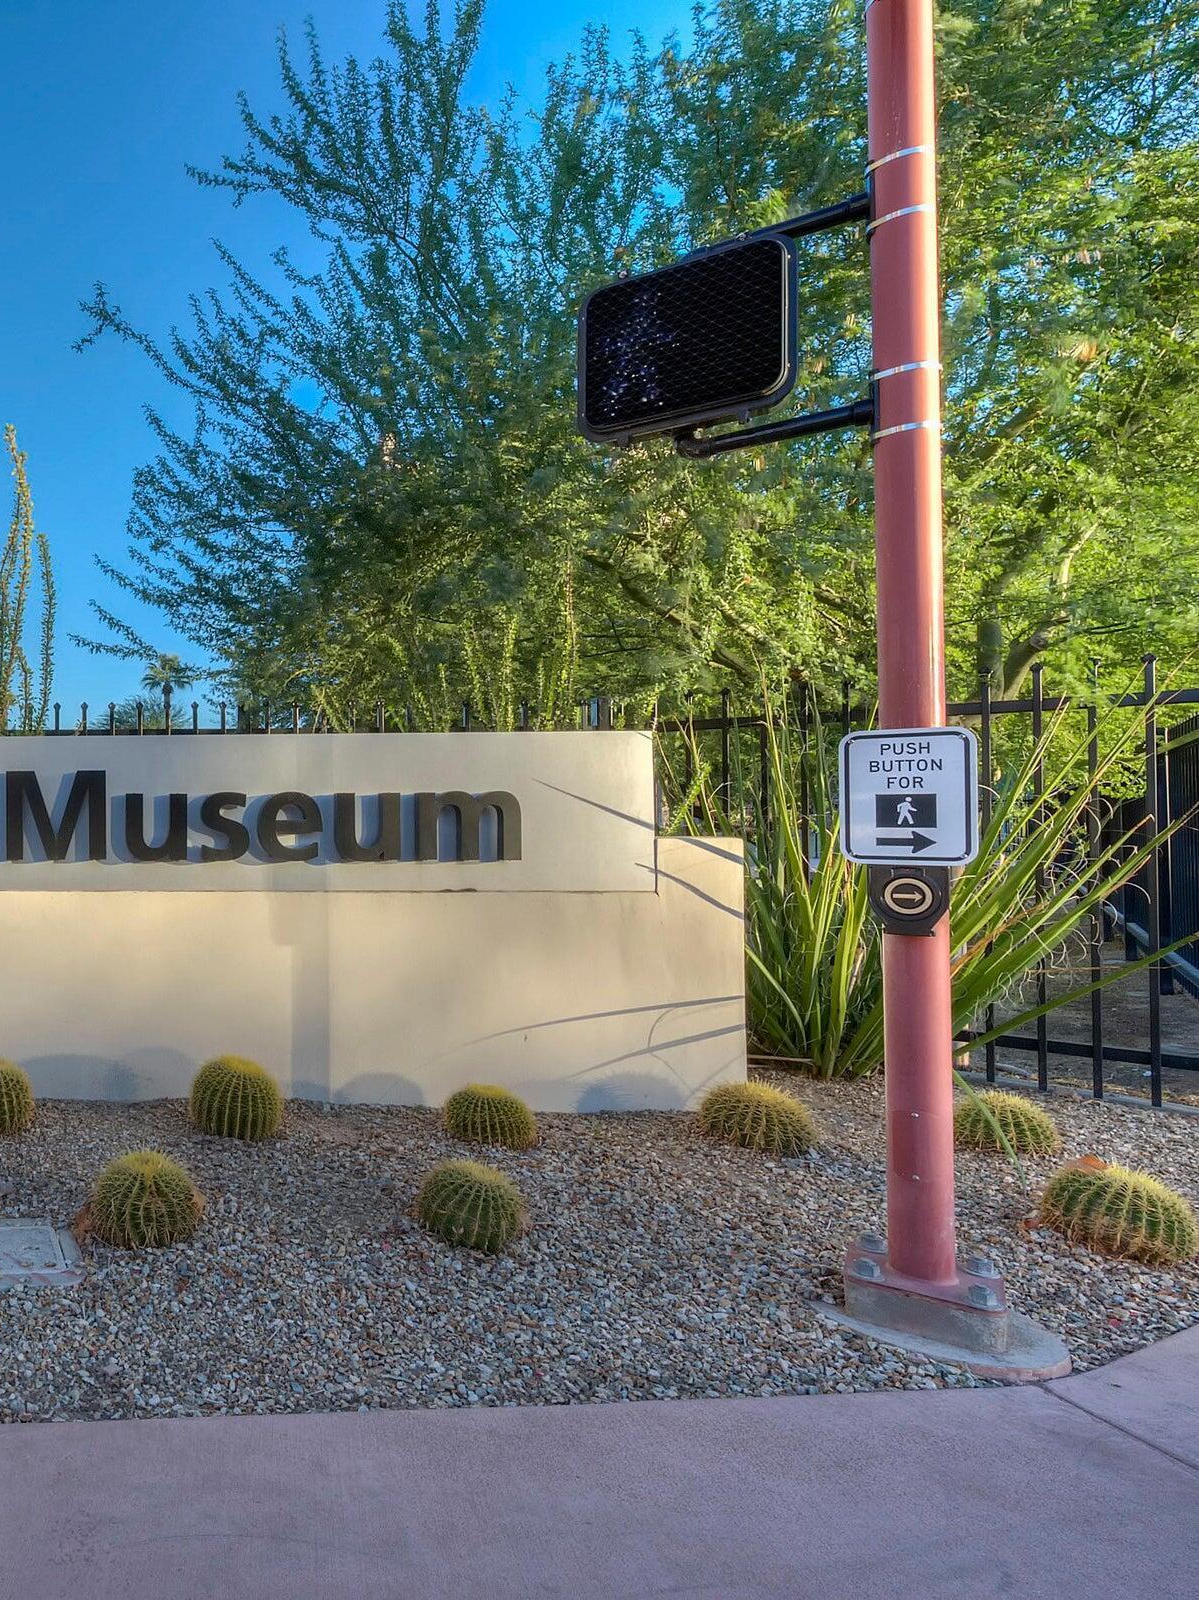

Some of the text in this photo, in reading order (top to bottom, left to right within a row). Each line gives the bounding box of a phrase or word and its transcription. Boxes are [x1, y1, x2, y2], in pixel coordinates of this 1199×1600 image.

[880, 742, 931, 756] PUSH
[869, 758, 943, 773] BUTTON
[887, 776, 924, 789] FOR
[5, 769, 522, 862] Museum
